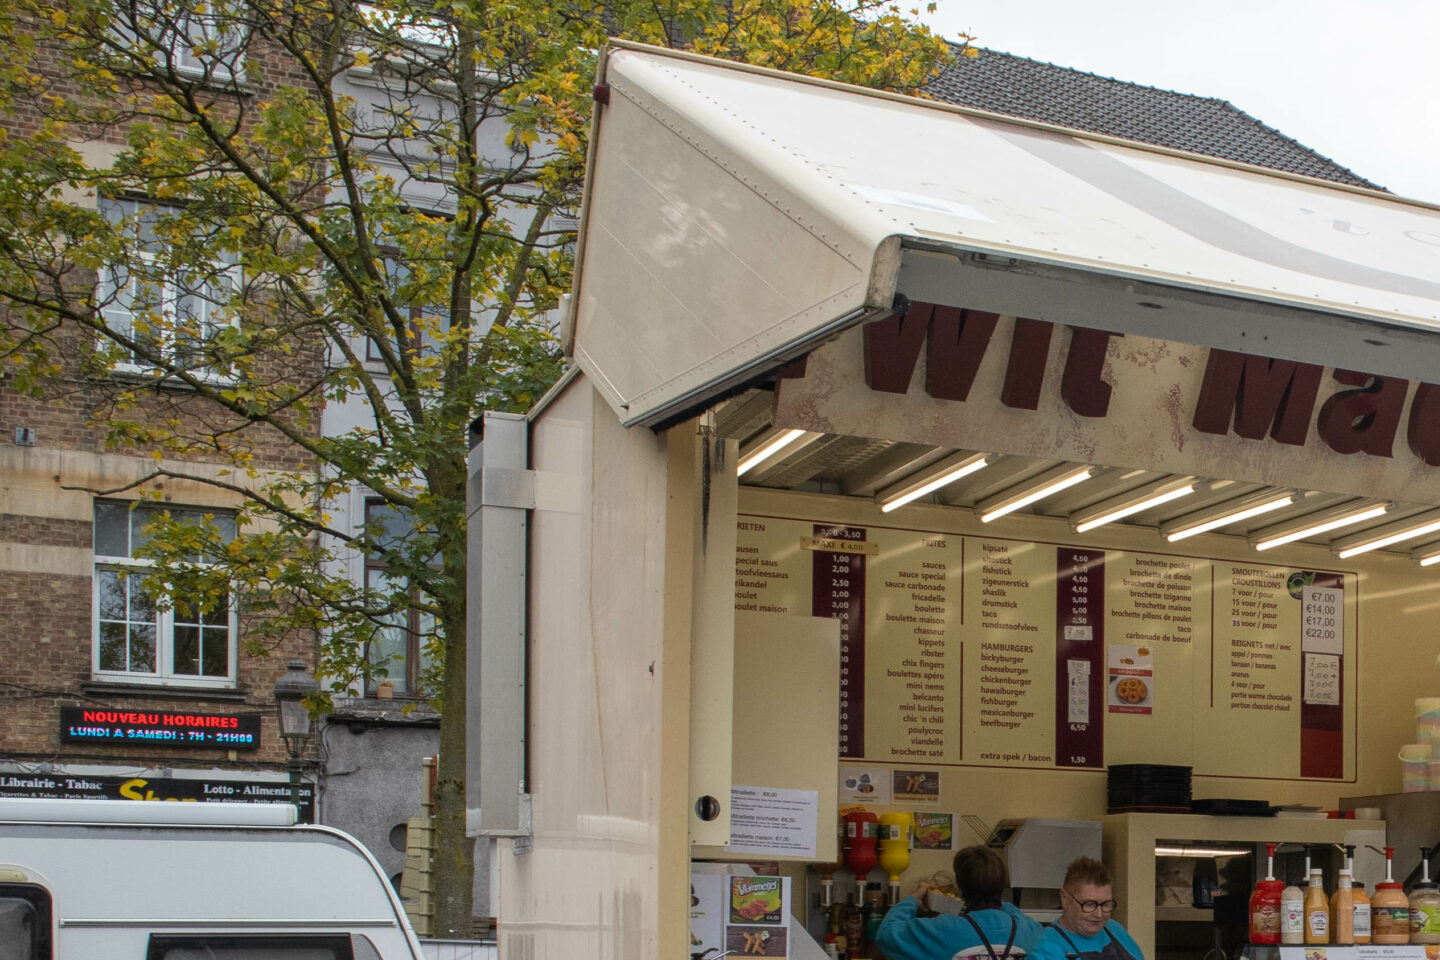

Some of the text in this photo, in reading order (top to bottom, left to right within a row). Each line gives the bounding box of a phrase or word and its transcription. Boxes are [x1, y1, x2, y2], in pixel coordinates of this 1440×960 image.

[832, 555, 849, 563] 1,00
[1136, 558, 1168, 568] brochette
[922, 560, 946, 570] sauces
[898, 570, 946, 581] sauce special
[982, 566, 1012, 576] fishstick
[1173, 573, 1192, 581] dinde
[832, 579, 849, 587] 2,50
[884, 580, 946, 592] sauce carbonade
[982, 578, 1030, 589] zigeunerstick
[1156, 581, 1165, 589] de
[1166, 583, 1191, 592] poisson
[1232, 577, 1281, 589] CROUSTILLONS
[912, 592, 946, 603] fricadelle
[982, 588, 1006, 598] shaslik
[1130, 590, 1192, 603] brochette tziganne
[1238, 590, 1253, 598] voor
[1311, 592, 1336, 604] €7,00
[915, 603, 945, 614] boulette
[982, 599, 1018, 609] drumstick
[1134, 601, 1191, 612] brochette maison
[1241, 600, 1256, 608] voor
[1262, 602, 1278, 611] pour
[1306, 604, 1336, 615] €14,00
[886, 613, 945, 625] boulette maison
[982, 610, 997, 618] taco
[1111, 609, 1191, 624] brochette de poulet
[1262, 612, 1278, 621] pour
[1262, 622, 1278, 631] pour
[1306, 616, 1336, 628] €17,00
[914, 626, 945, 636] chasseur
[1306, 628, 1335, 640] €22,00
[918, 638, 945, 649] kippets
[1126, 632, 1191, 644] carbonade de boeuf
[981, 643, 1033, 653] HAMBURGERS
[1231, 640, 1264, 649] BEIGNETS
[921, 649, 945, 658] ribster
[981, 654, 1024, 665] bickyburger
[919, 660, 945, 671] fingers
[981, 665, 1029, 676] cheeseburger
[887, 669, 922, 679] boulettes
[907, 681, 944, 691] mini nems
[980, 676, 1032, 686] chickenburger
[913, 692, 944, 702] belcanto
[980, 686, 1026, 697] hawaiburger
[899, 703, 944, 713] mini lucifers
[980, 697, 1019, 708] fishburger
[980, 708, 1035, 719] mexicanburger
[83, 711, 238, 728] NOUVEAU HORAIRES
[929, 715, 944, 724] chili
[980, 719, 1021, 730] beefburger
[69, 726, 110, 737] LUNDI
[128, 729, 177, 740] SAMEDI
[188, 731, 204, 741] 7H
[911, 737, 944, 746] viandelle
[891, 747, 927, 757] brochette
[980, 752, 1052, 763] extra spek bacon
[1070, 756, 1086, 764] 1,50
[0, 777, 103, 790] Librairie Tabac
[204, 784, 311, 797] Lotto Alimentaon
